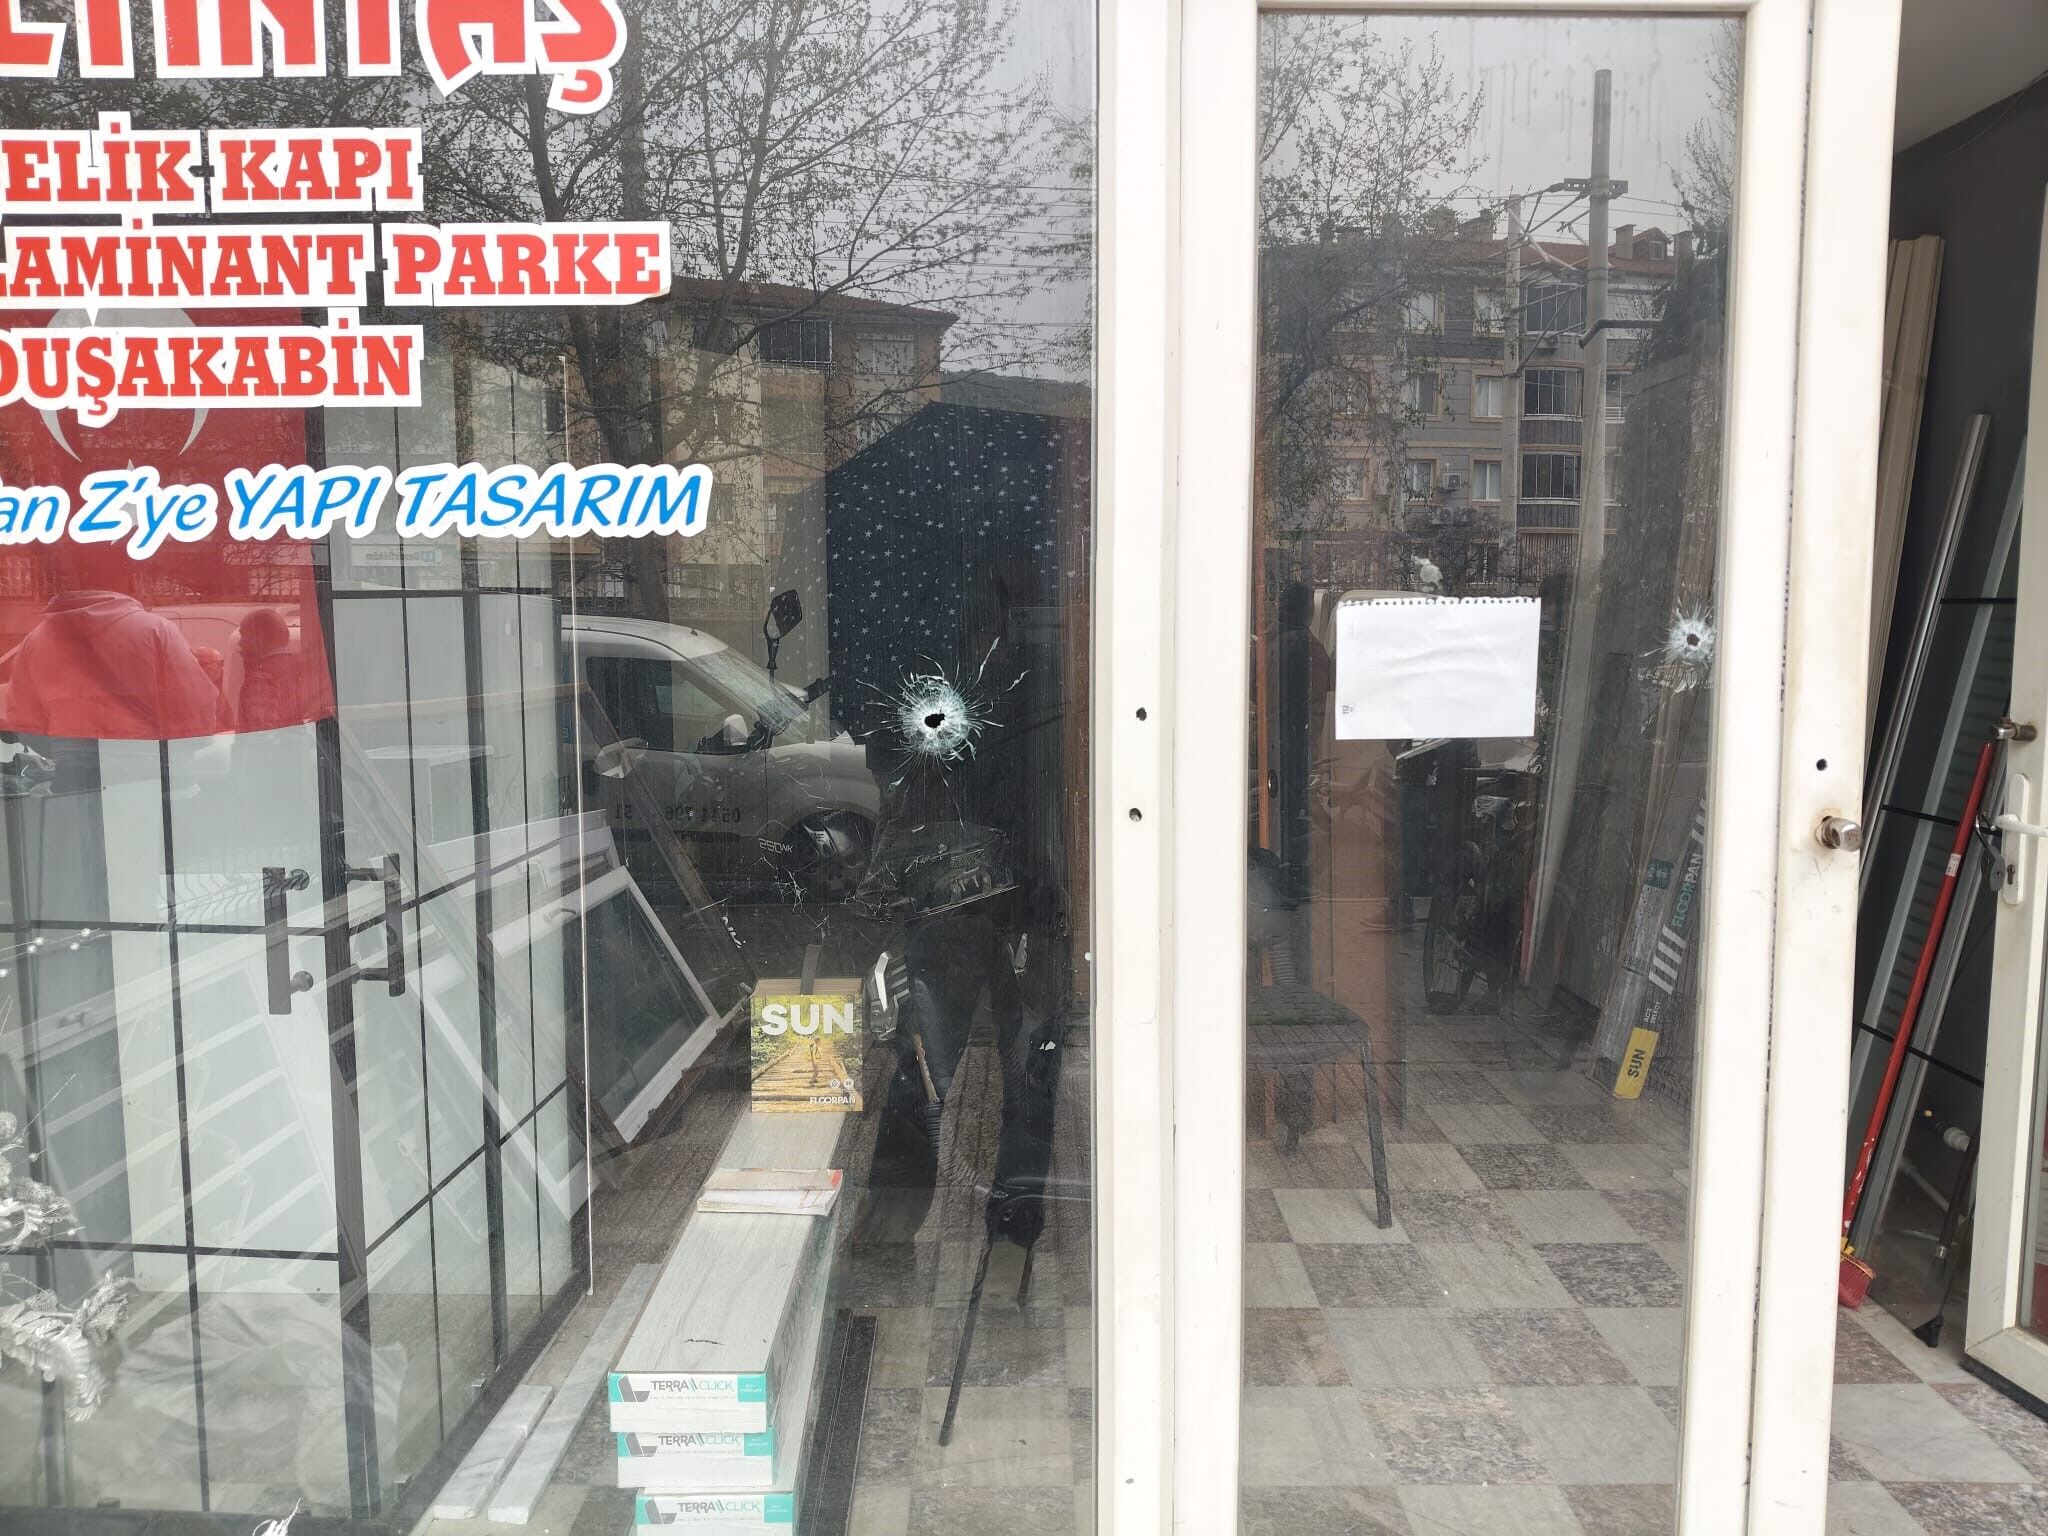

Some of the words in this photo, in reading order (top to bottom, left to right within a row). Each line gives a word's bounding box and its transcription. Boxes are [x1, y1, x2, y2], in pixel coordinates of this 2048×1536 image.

[220, 139, 414, 201] KAPI
[0, 218, 364, 297] AMİNANT
[393, 234, 661, 295] PARKE
[78, 477, 207, 548] Z'ye
[235, 474, 381, 529] YAPI
[404, 473, 702, 527] TASARIM
[1671, 852, 1701, 928] FLOORPAN
[761, 1002, 855, 1036] SUN
[1627, 1049, 1646, 1077] SUN
[810, 1096, 856, 1105] FLOORPAN
[651, 1380, 690, 1392] TERRA
